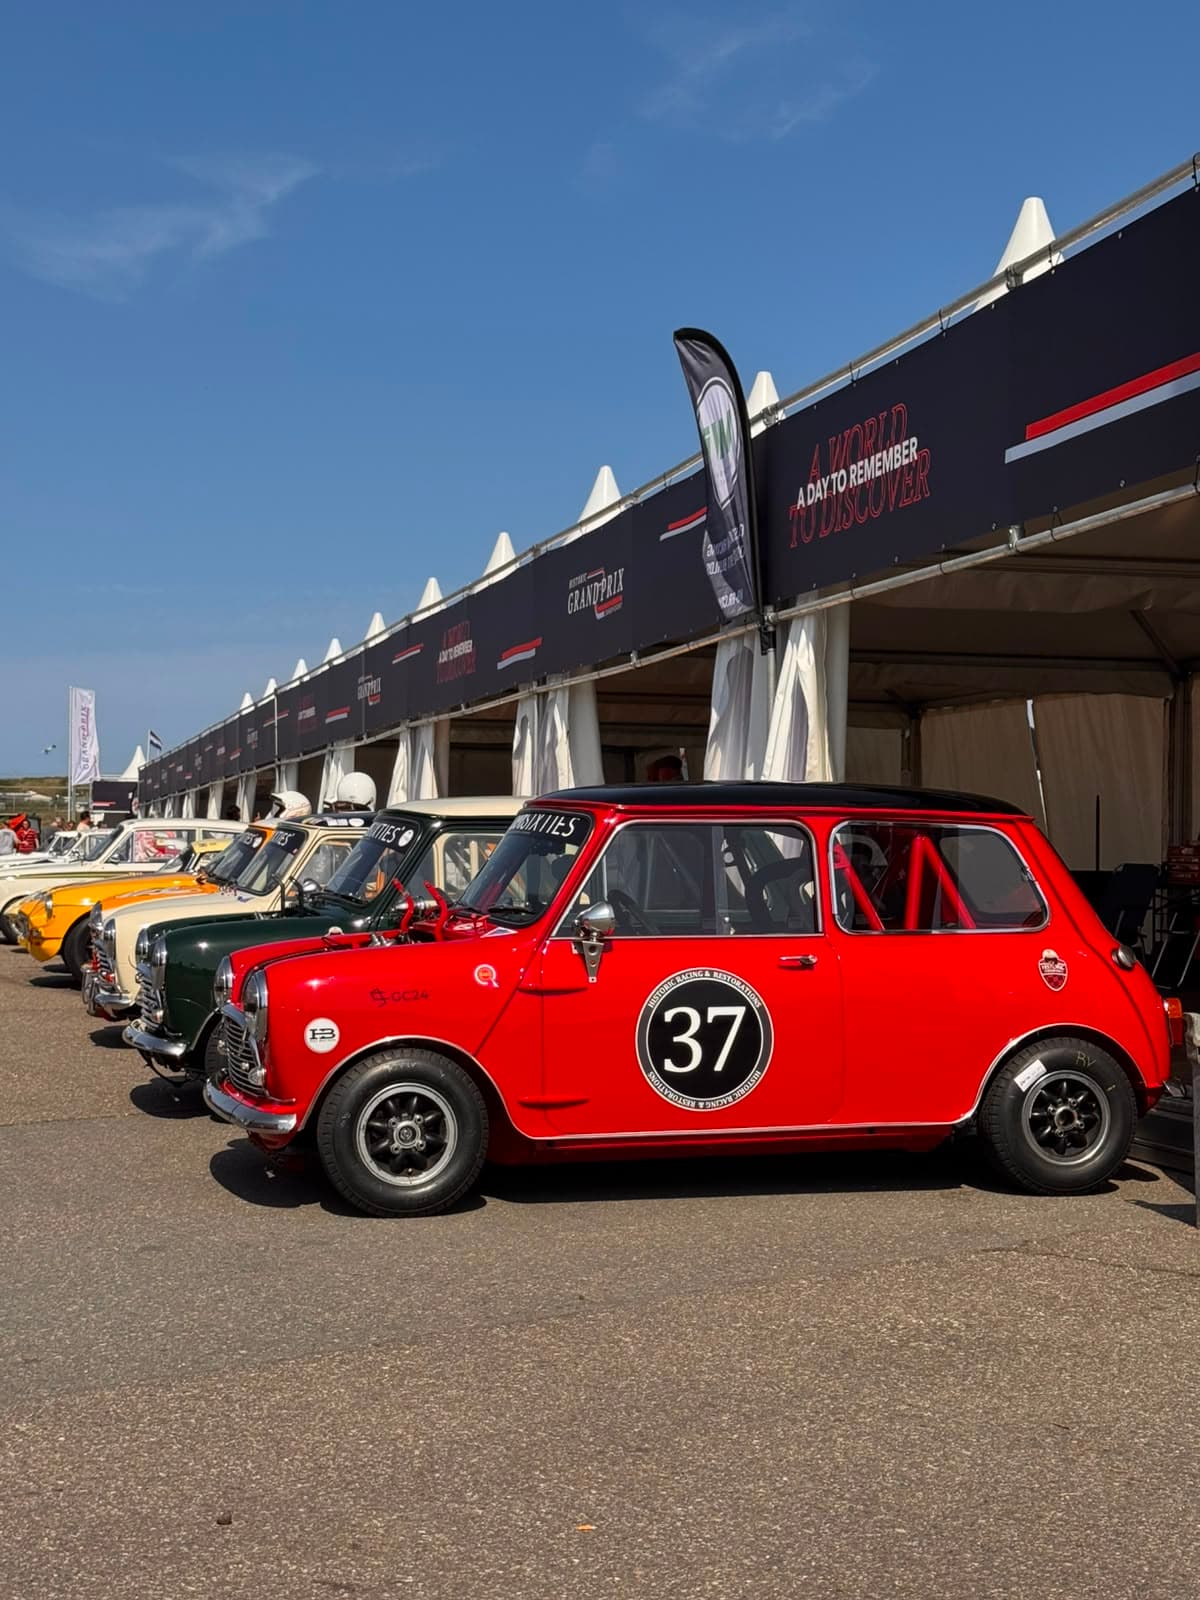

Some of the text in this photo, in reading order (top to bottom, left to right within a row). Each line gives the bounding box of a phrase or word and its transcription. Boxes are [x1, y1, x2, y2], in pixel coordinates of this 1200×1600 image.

[796, 437, 918, 510] A DAY TO REMEMBER
[820, 448, 931, 538] DISCOVER
[568, 568, 624, 614] GRAND PRIX
[391, 990, 429, 1002] GC24
[648, 979, 677, 1009] HISTORIC
[676, 970, 705, 984] RACING
[713, 970, 763, 1009] RESTORATIONS
[663, 1006, 746, 1073] 37
[648, 1070, 697, 1109] RESTORATIONS
[705, 1096, 734, 1110] RACING
[732, 1070, 762, 1101] HISTORIC
